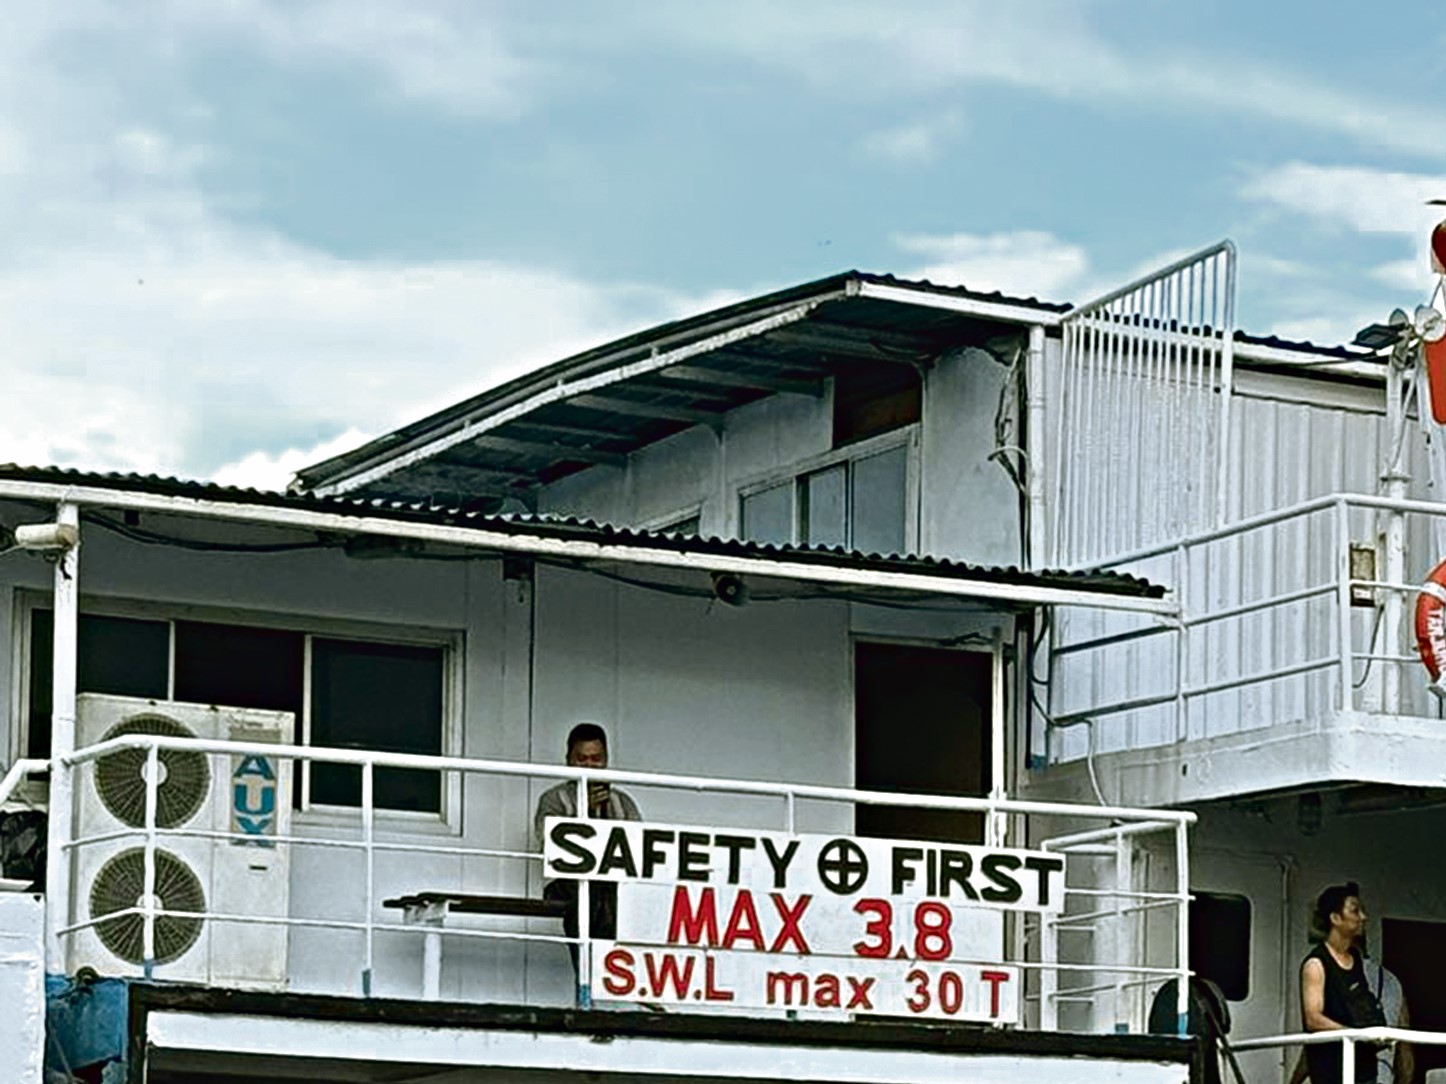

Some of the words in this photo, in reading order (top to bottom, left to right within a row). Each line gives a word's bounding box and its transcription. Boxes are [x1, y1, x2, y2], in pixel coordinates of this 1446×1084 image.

[231, 752, 278, 848] AUX
[549, 821, 800, 889] SAFETY
[891, 846, 1064, 907] FIRST
[667, 885, 813, 955] MAX
[853, 898, 953, 961] 3.8
[602, 950, 735, 1001] S.W.L
[766, 970, 876, 1011] max
[905, 970, 964, 1015] 30
[980, 971, 1011, 1018] T
